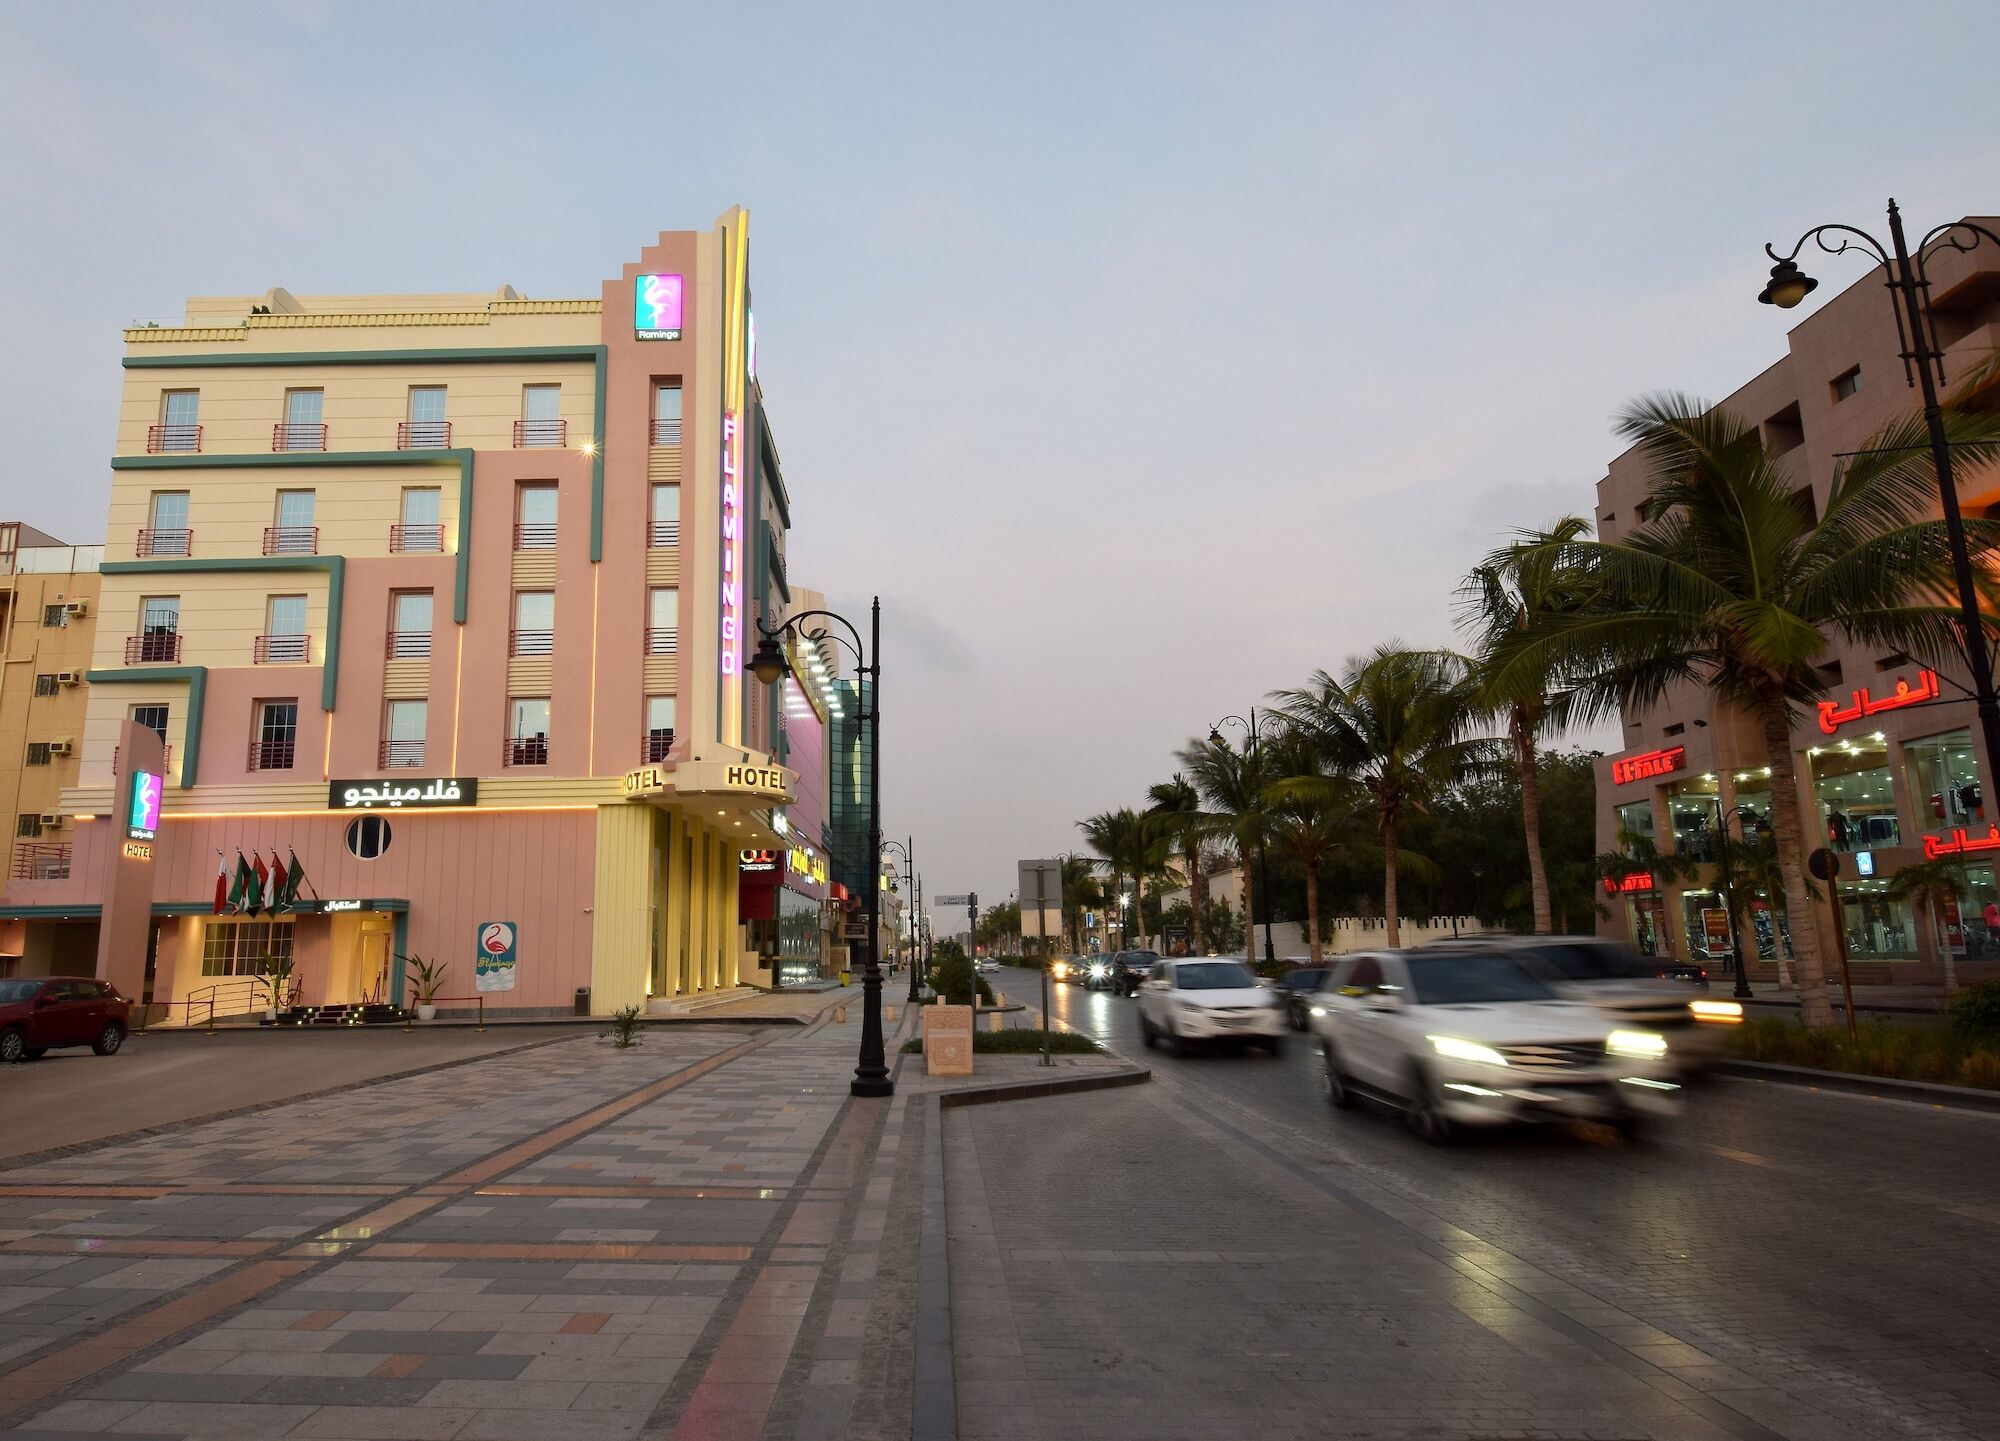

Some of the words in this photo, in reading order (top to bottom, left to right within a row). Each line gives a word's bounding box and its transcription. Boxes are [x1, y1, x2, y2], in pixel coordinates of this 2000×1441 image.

[638, 330, 679, 340] Flamingo
[723, 419, 737, 675] FLAMINGO
[728, 767, 786, 790] HOTEL
[344, 779, 461, 807] فلامينجو
[126, 844, 153, 858] HOTEL
[324, 900, 361, 912] استقبال
